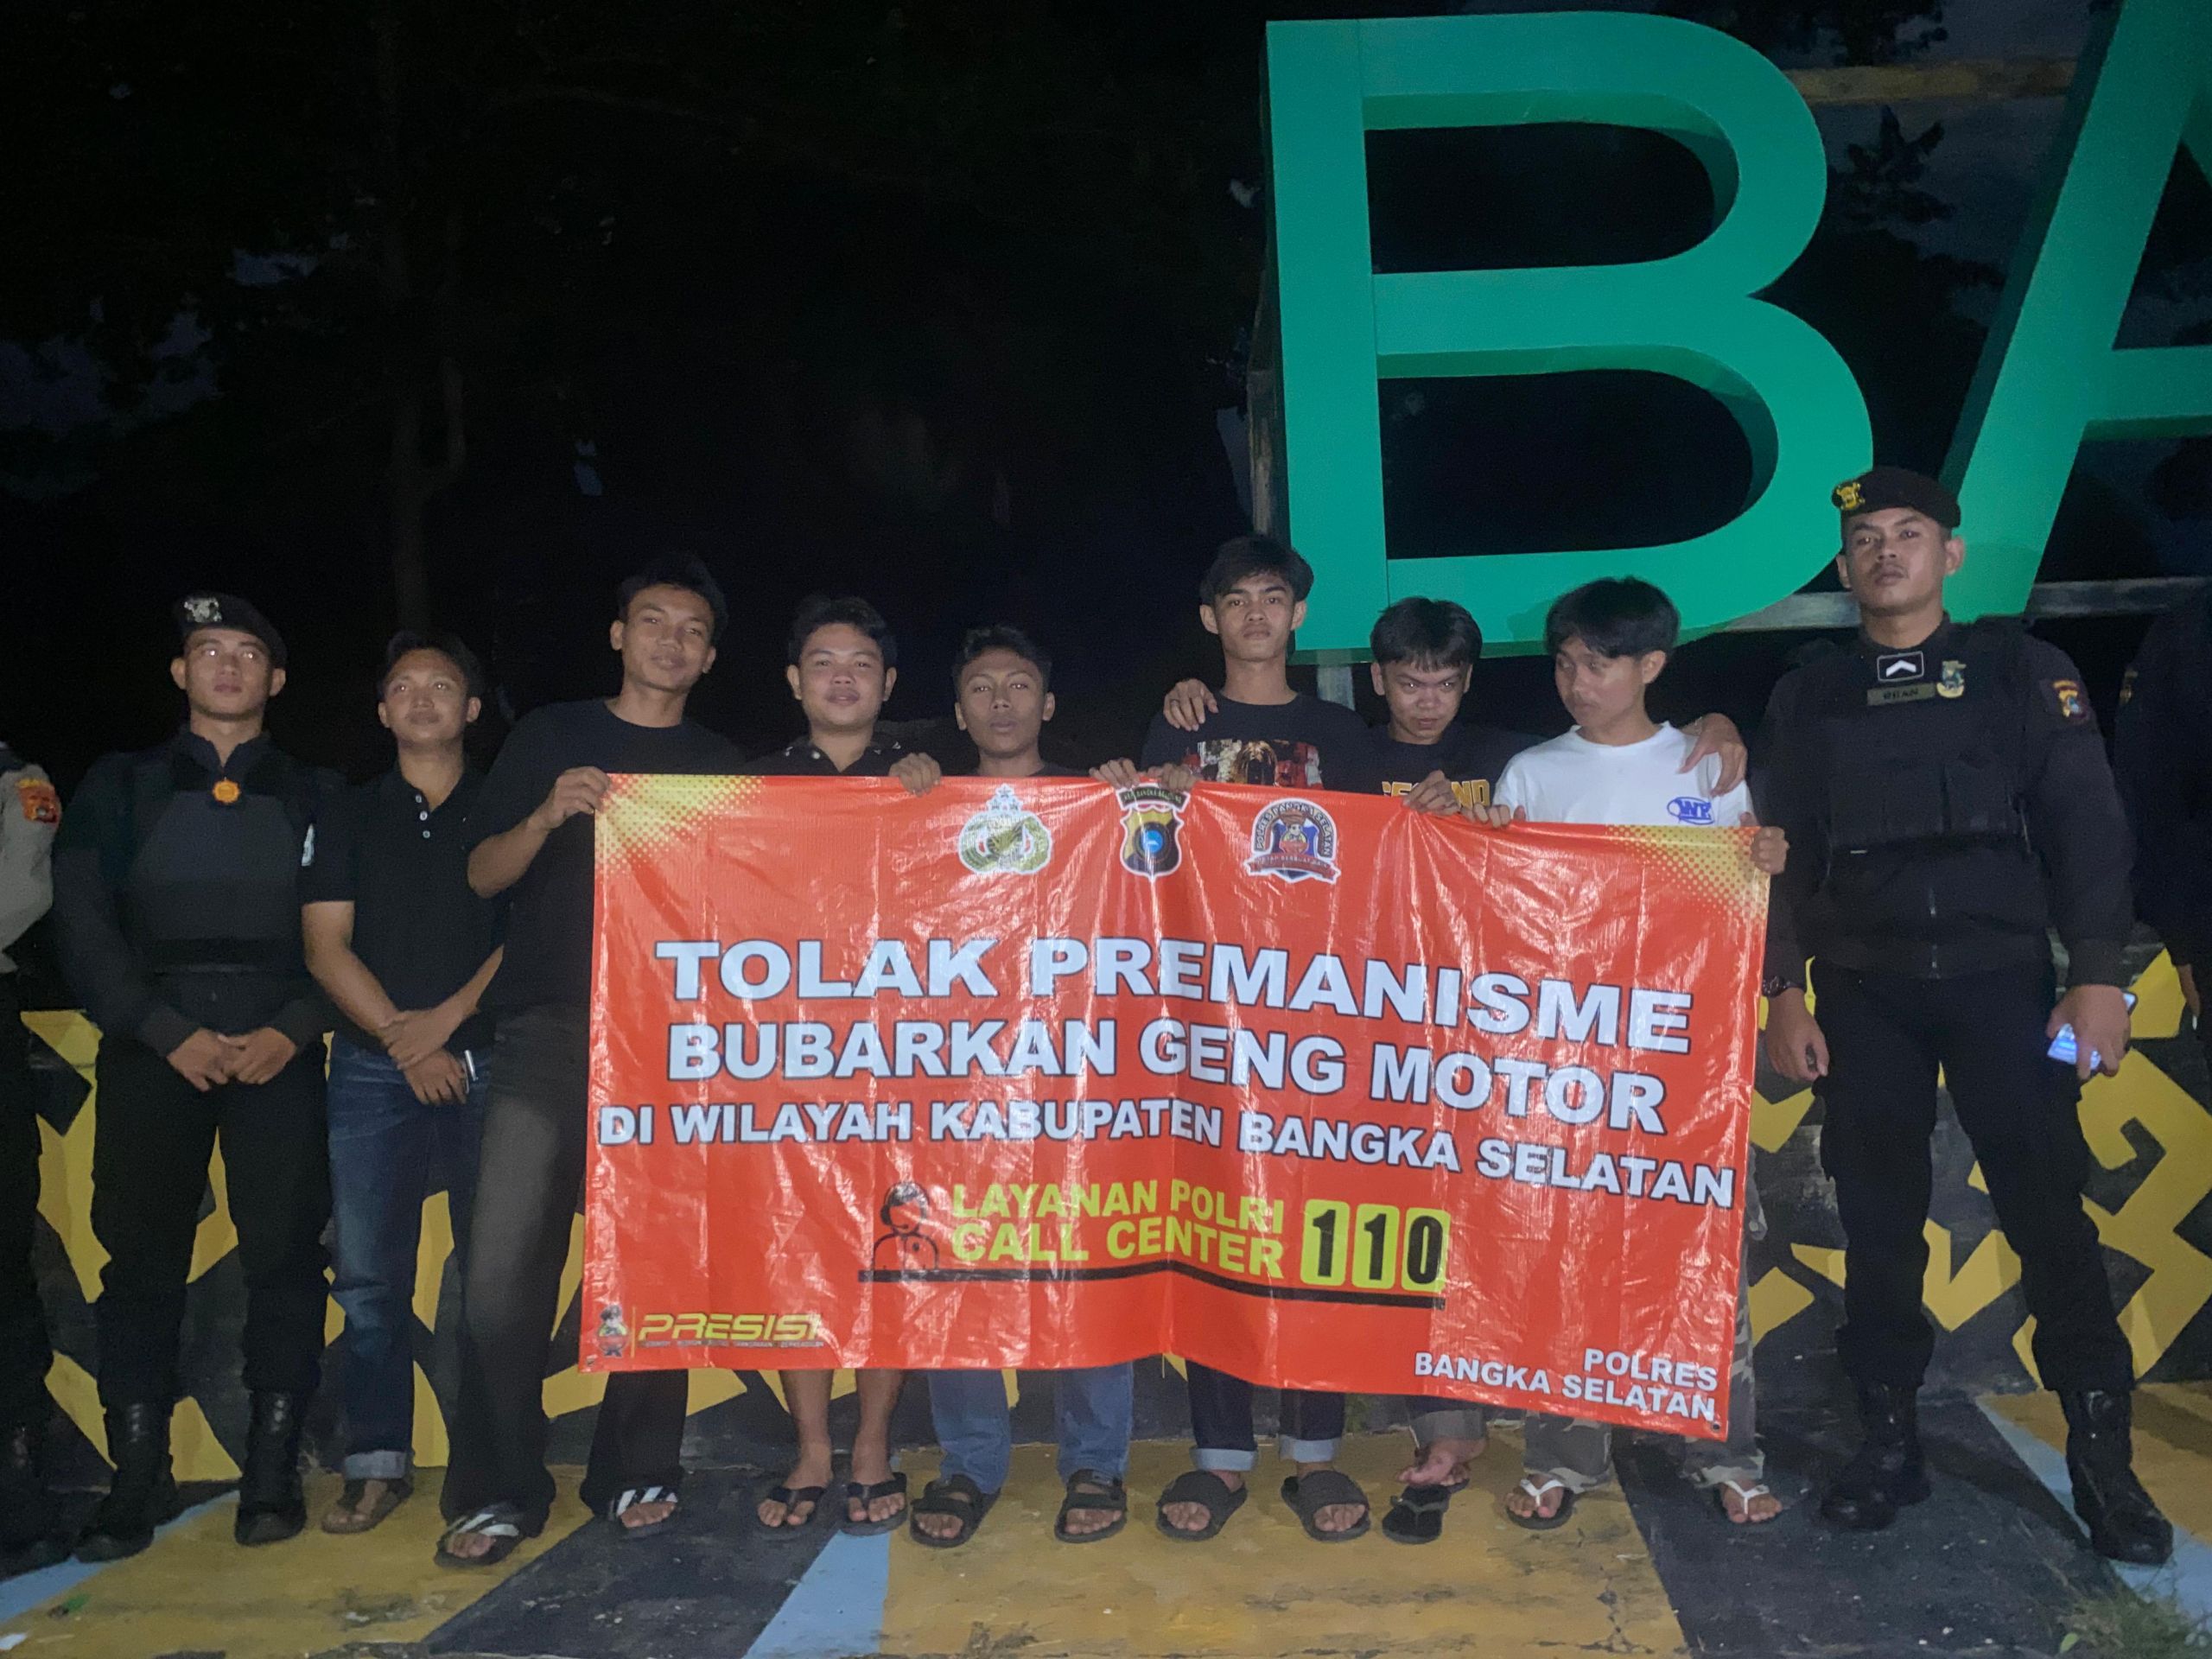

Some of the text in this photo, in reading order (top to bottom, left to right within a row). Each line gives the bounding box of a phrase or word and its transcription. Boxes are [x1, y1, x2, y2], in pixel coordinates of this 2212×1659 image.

[655, 937, 1693, 1053] TOLAK PREMANISME
[668, 1018, 1666, 1135] BUBARKAN GENG MOTOR
[599, 1100, 1735, 1209] DI WILAYAH KABUPATEN BANGKA SELATAN
[952, 1179, 1284, 1234] LAYANAN POLRI
[952, 1216, 1284, 1279] CALL CENTER
[1313, 1209, 1443, 1285] 110
[638, 1313, 821, 1340] PRESISI
[1414, 1352, 1715, 1421] BANGKA SELATAN
[1583, 1348, 1718, 1391] POLRES
